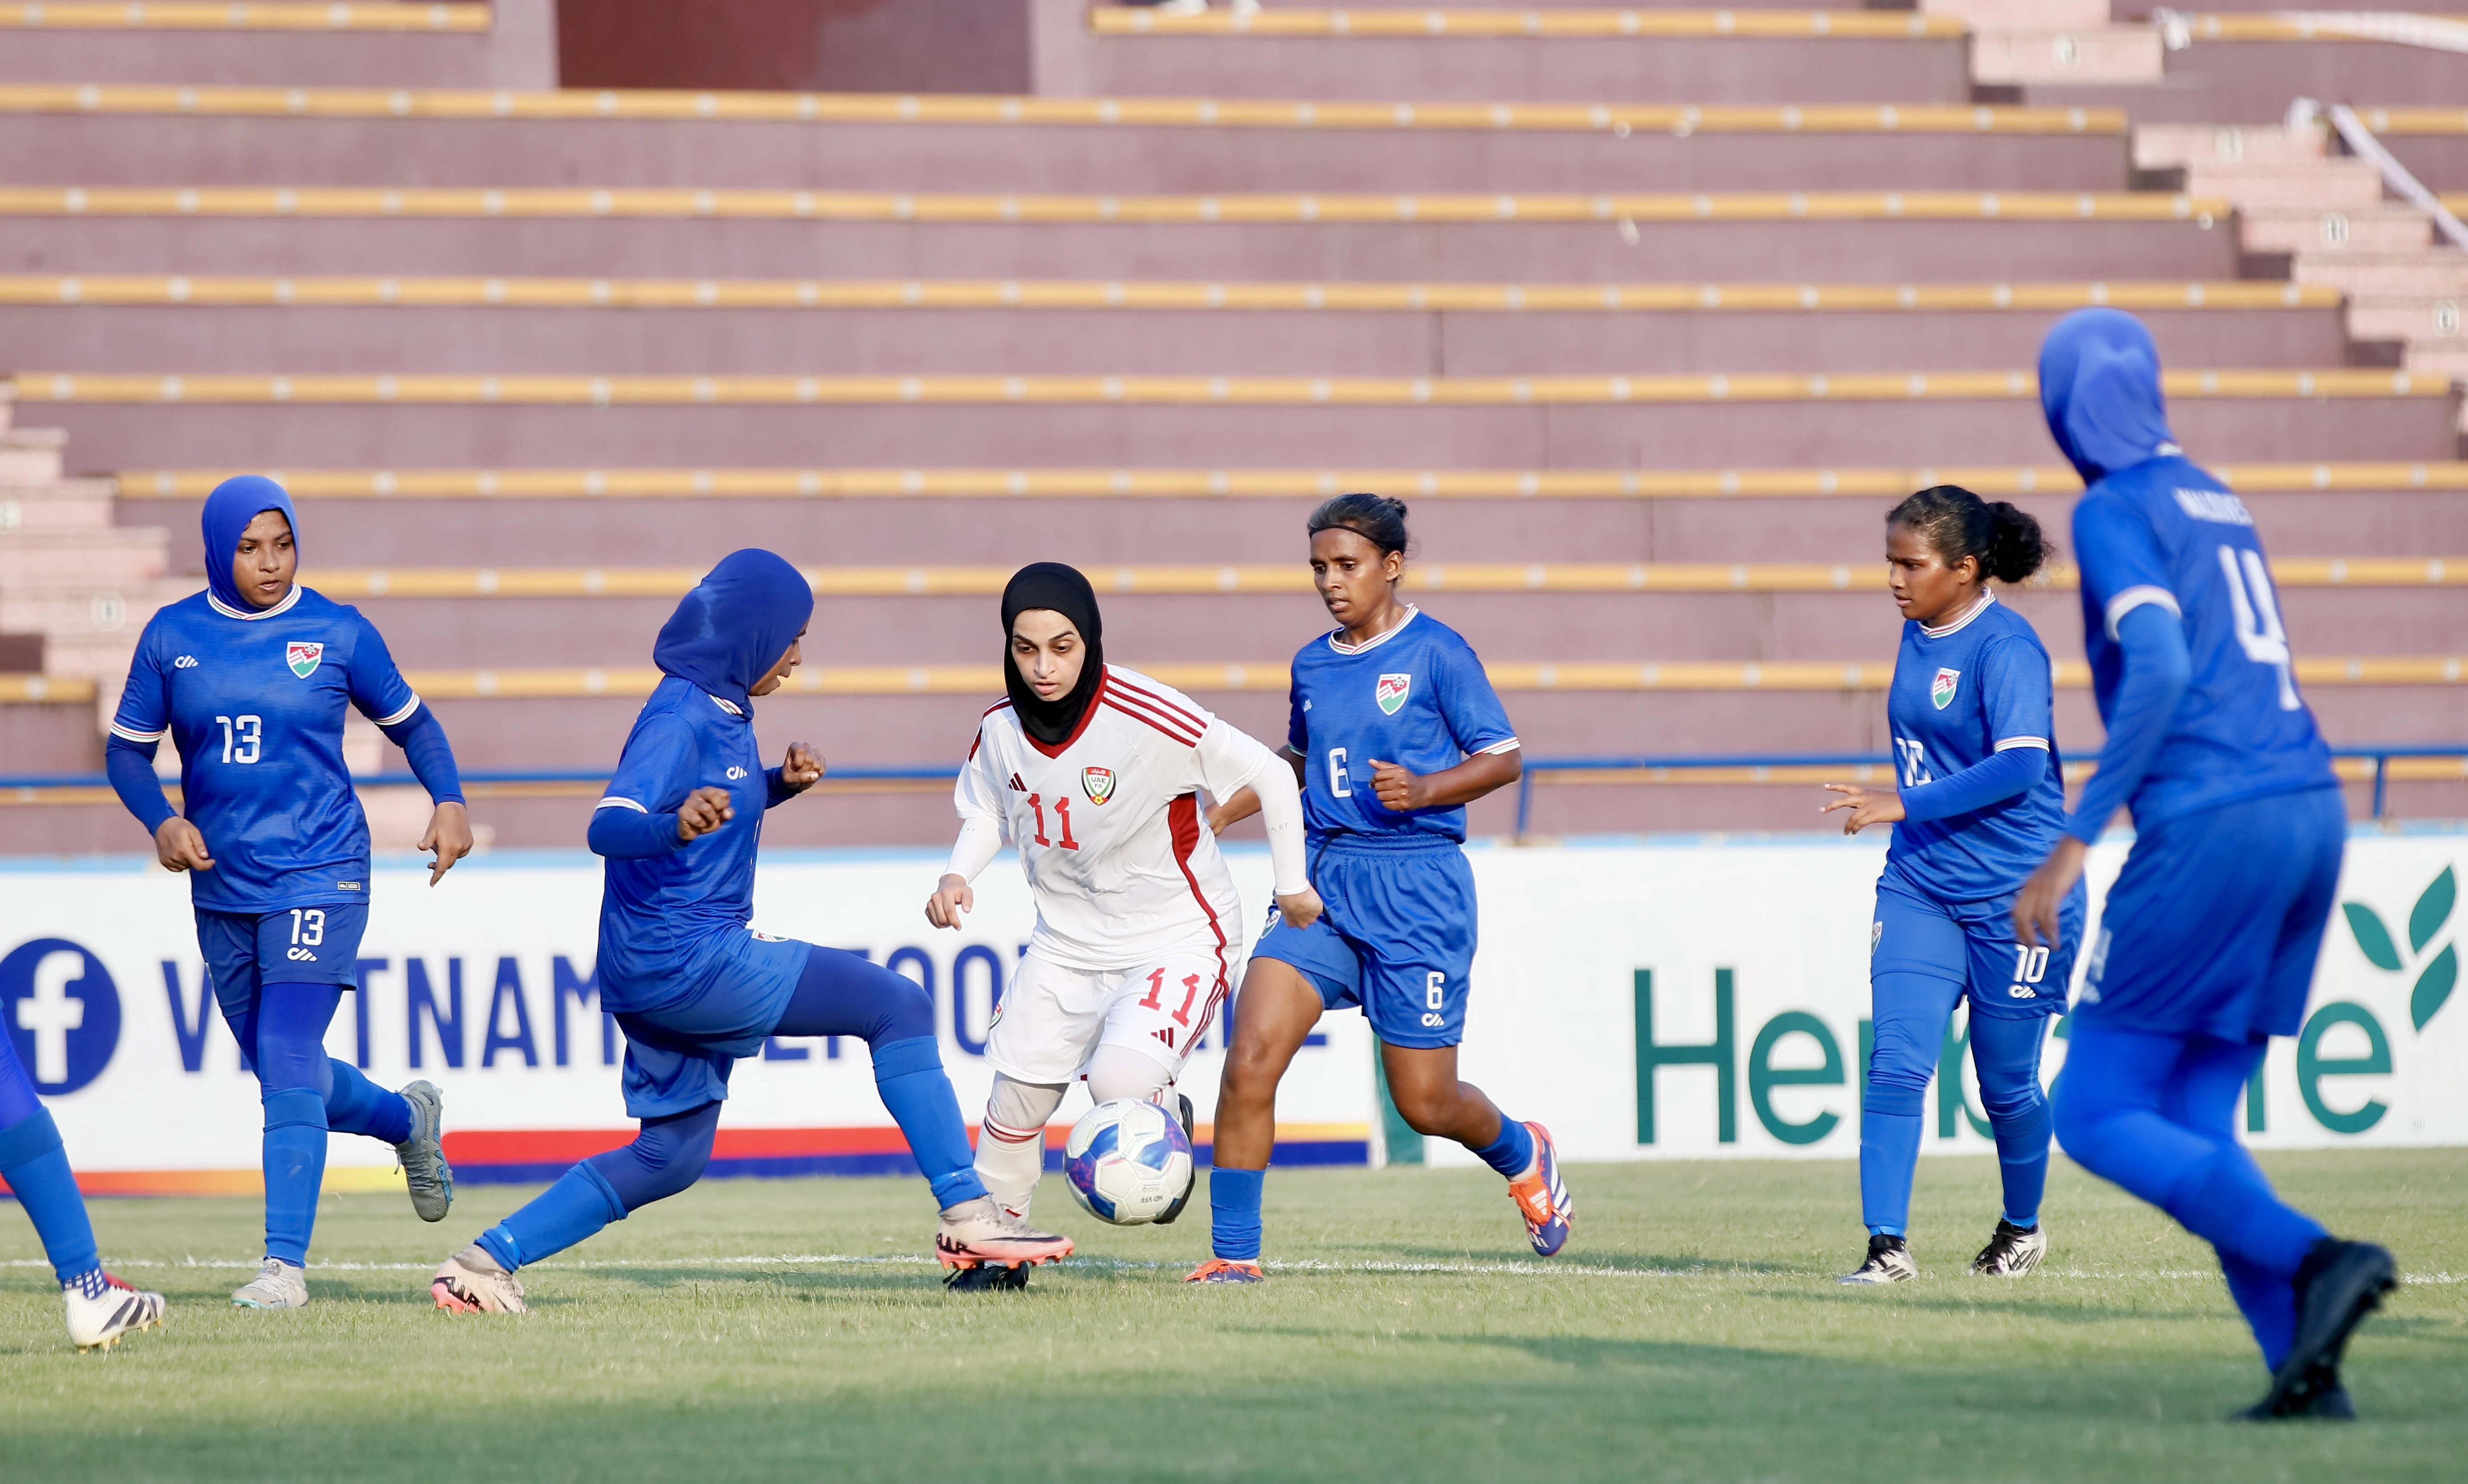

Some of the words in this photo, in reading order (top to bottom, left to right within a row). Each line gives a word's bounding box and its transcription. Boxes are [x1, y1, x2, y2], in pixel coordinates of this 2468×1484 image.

[2218, 545, 2301, 711] 4
[216, 715, 262, 764] 13
[1329, 748, 1352, 798] 6
[1027, 793, 1079, 851] 11
[291, 909, 326, 946] 13
[2014, 944, 2050, 983] 10
[1138, 967, 1200, 1027] 11
[1426, 971, 1445, 1010] 6
